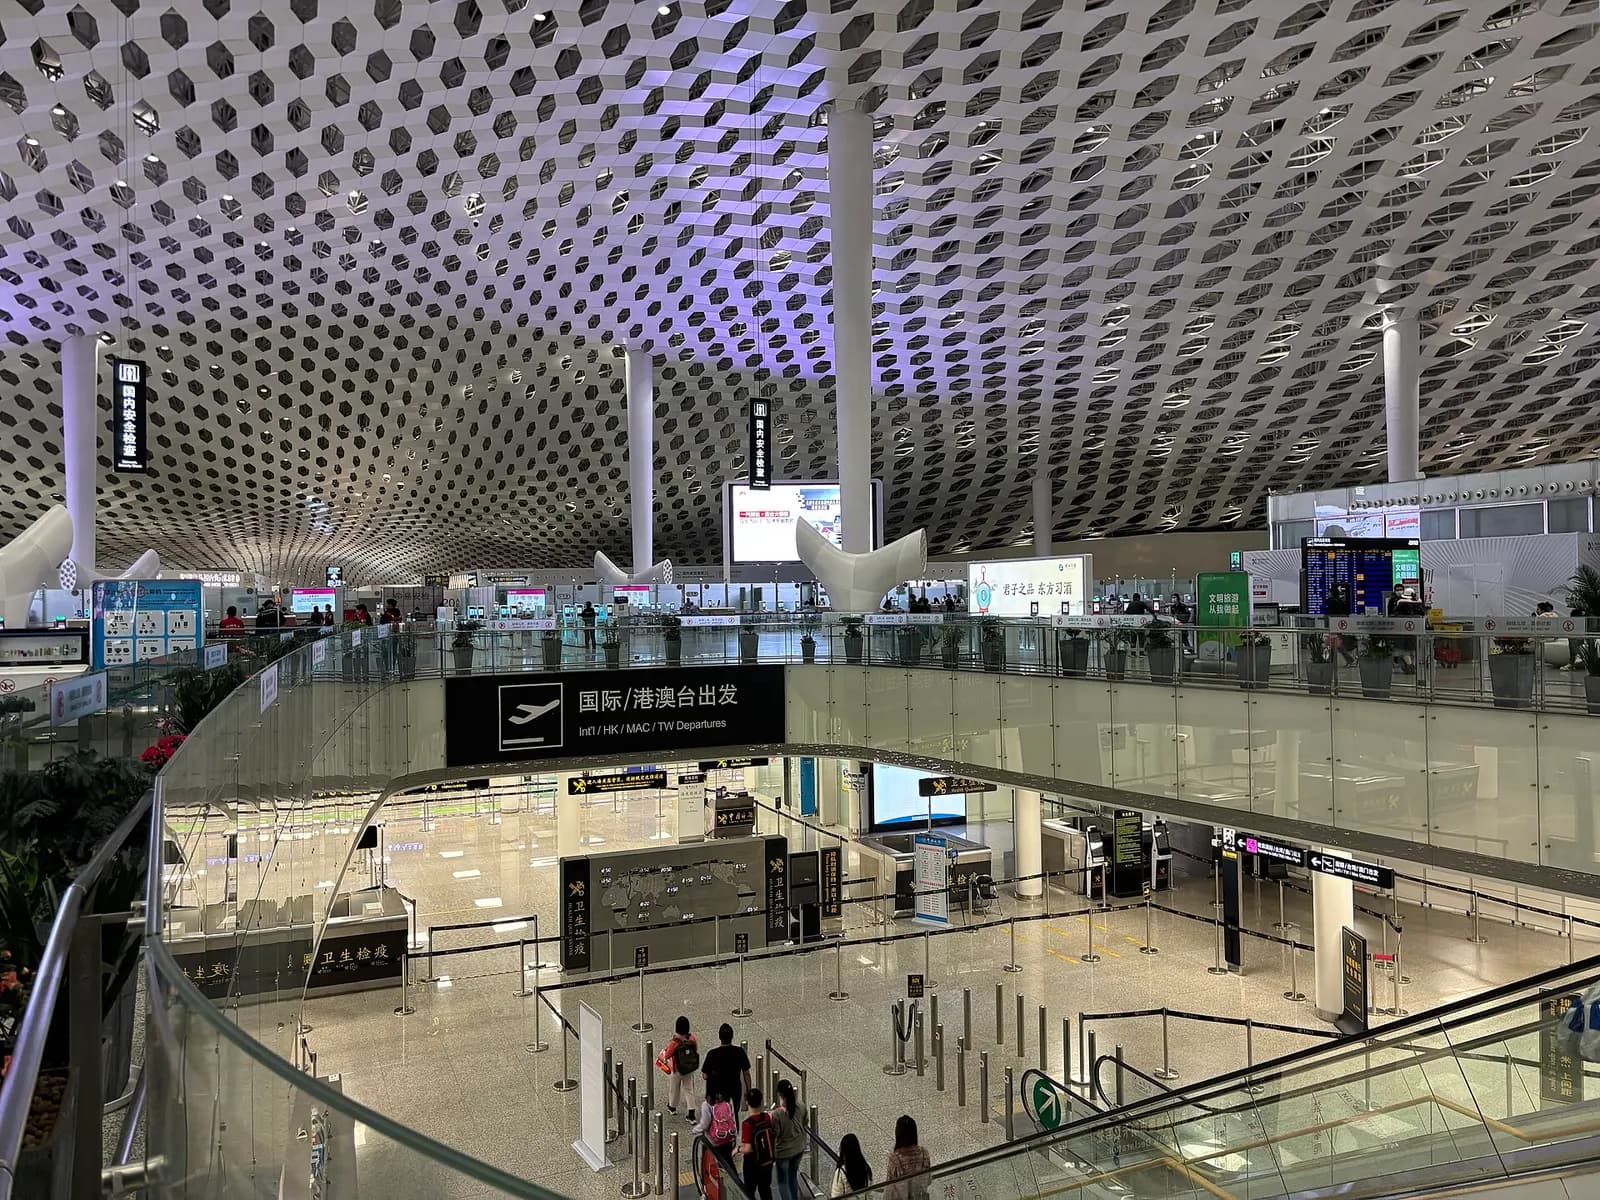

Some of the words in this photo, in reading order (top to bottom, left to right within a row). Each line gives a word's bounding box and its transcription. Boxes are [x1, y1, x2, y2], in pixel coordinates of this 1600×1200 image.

[122, 385, 136, 457] 国内安全检查
[1003, 583, 1034, 596] 君子之品
[1209, 593, 1239, 603] 文明旅游
[1209, 604, 1239, 614] 从我做起
[579, 683, 738, 713] 国际/港澳台出发
[579, 726, 595, 736] Int'l
[603, 724, 619, 735] HK
[626, 722, 650, 734] MAC
[657, 720, 675, 731] TW
[677, 719, 727, 732] Departures
[774, 877, 785, 928] 卫生检疫
[321, 943, 388, 965] 卫生检疫
